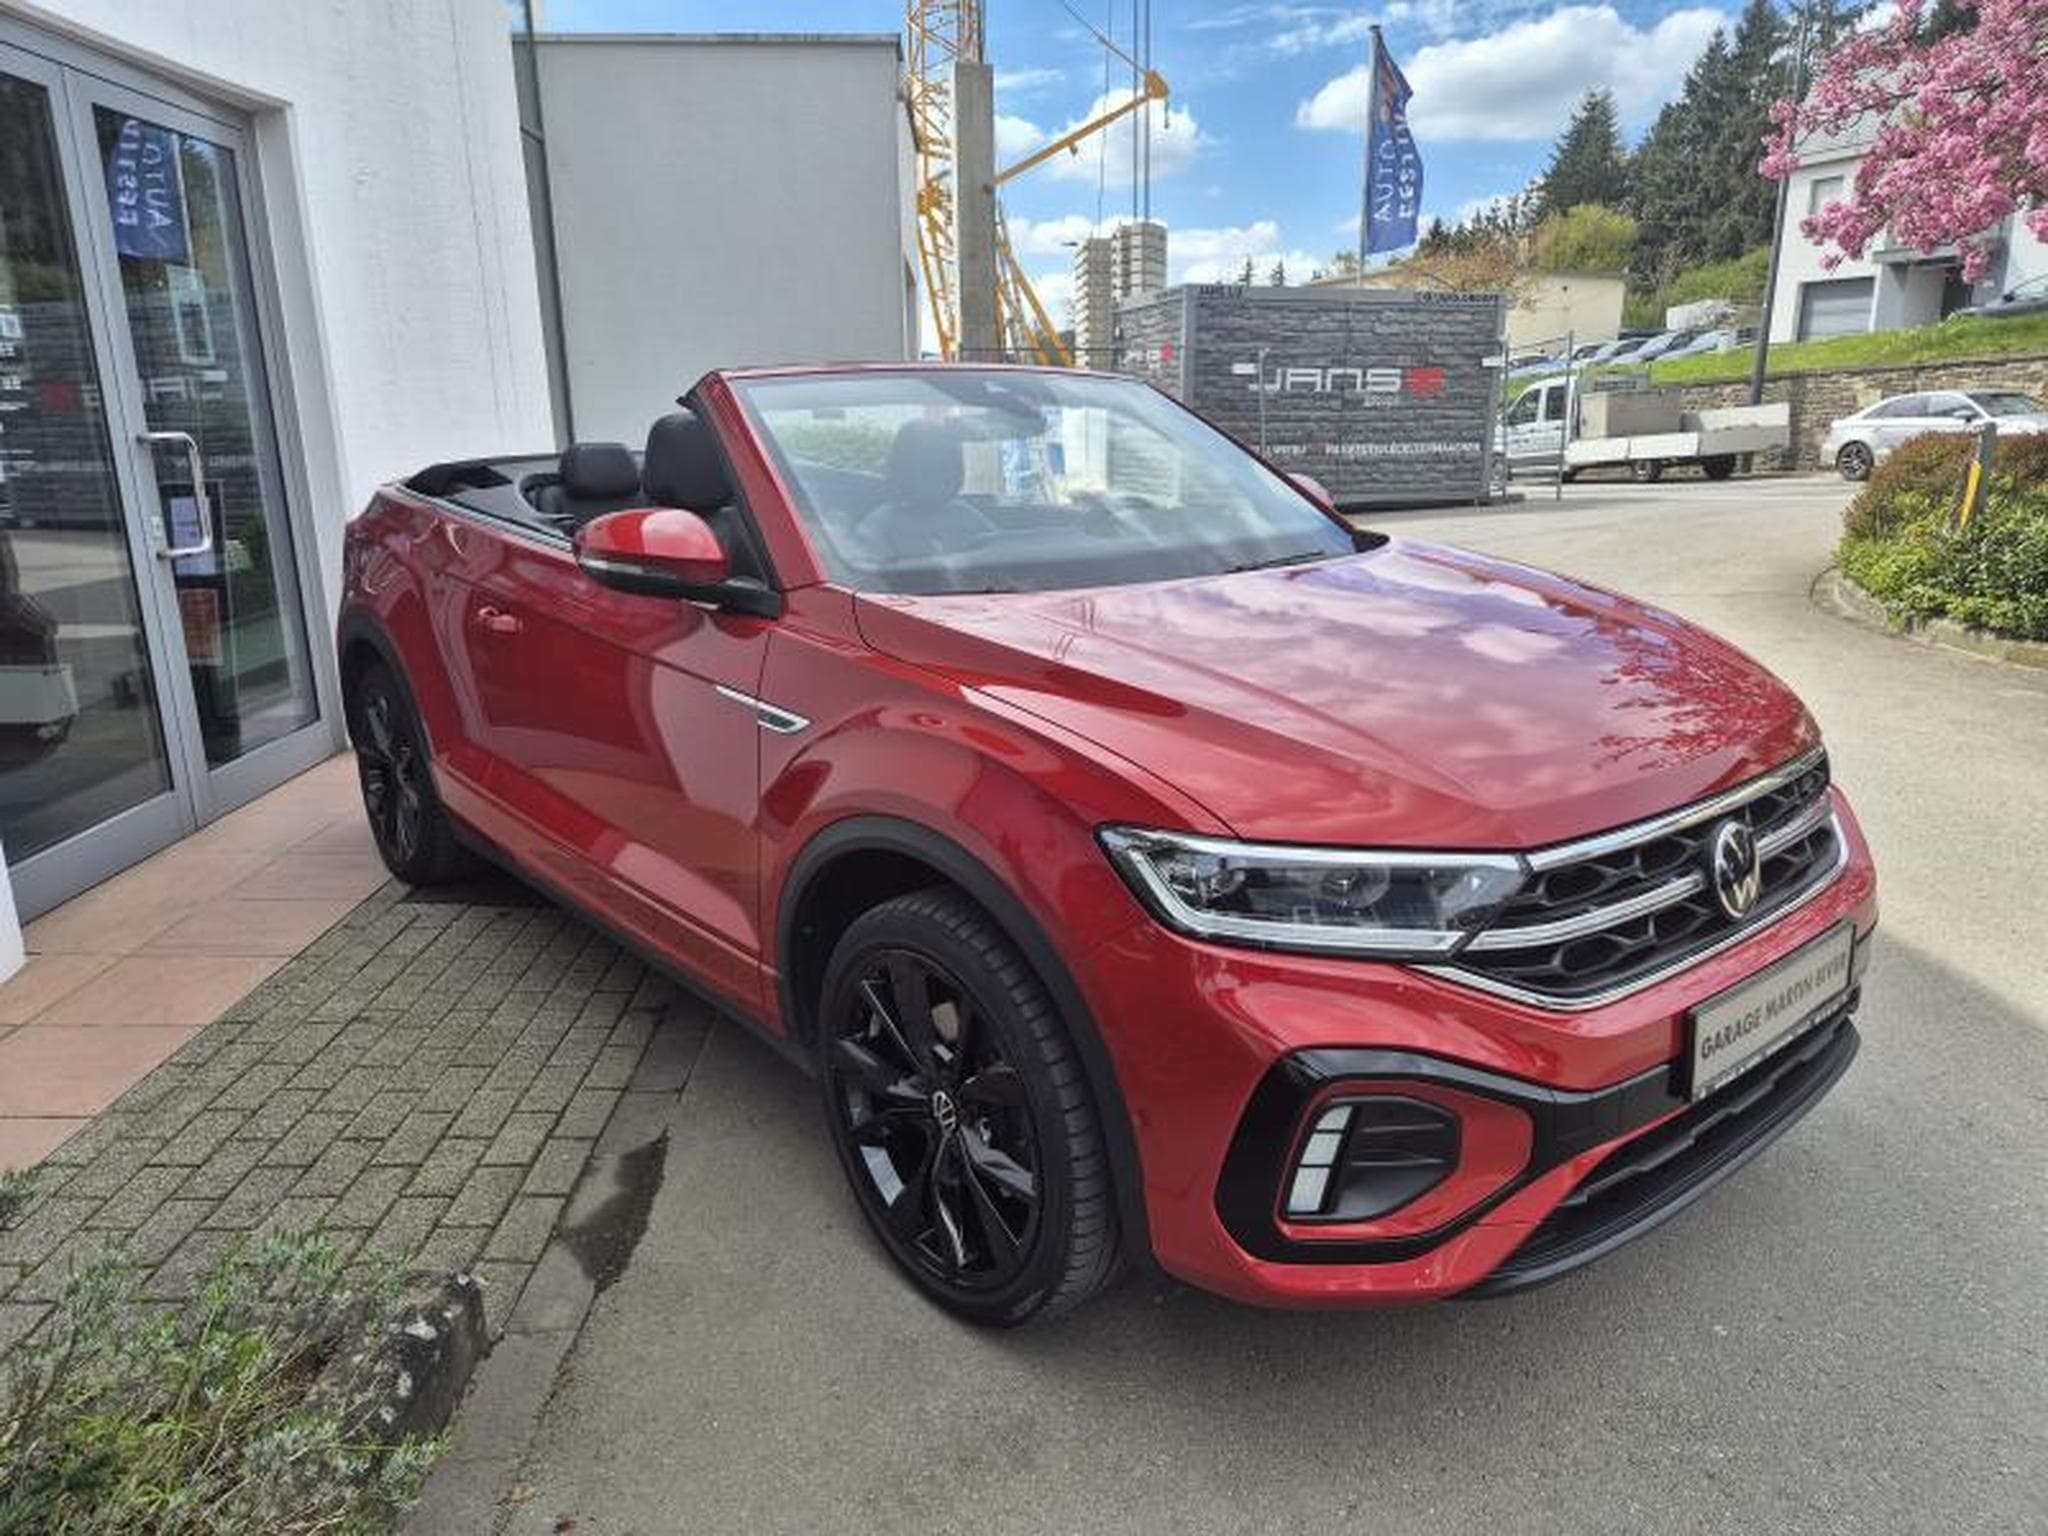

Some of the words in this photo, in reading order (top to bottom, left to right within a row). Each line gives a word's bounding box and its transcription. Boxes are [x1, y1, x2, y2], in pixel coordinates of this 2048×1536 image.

[1373, 139, 1396, 222] AUTO
[1393, 102, 1416, 219] FESTIV
[1701, 1006, 1761, 1058] GARAGE
